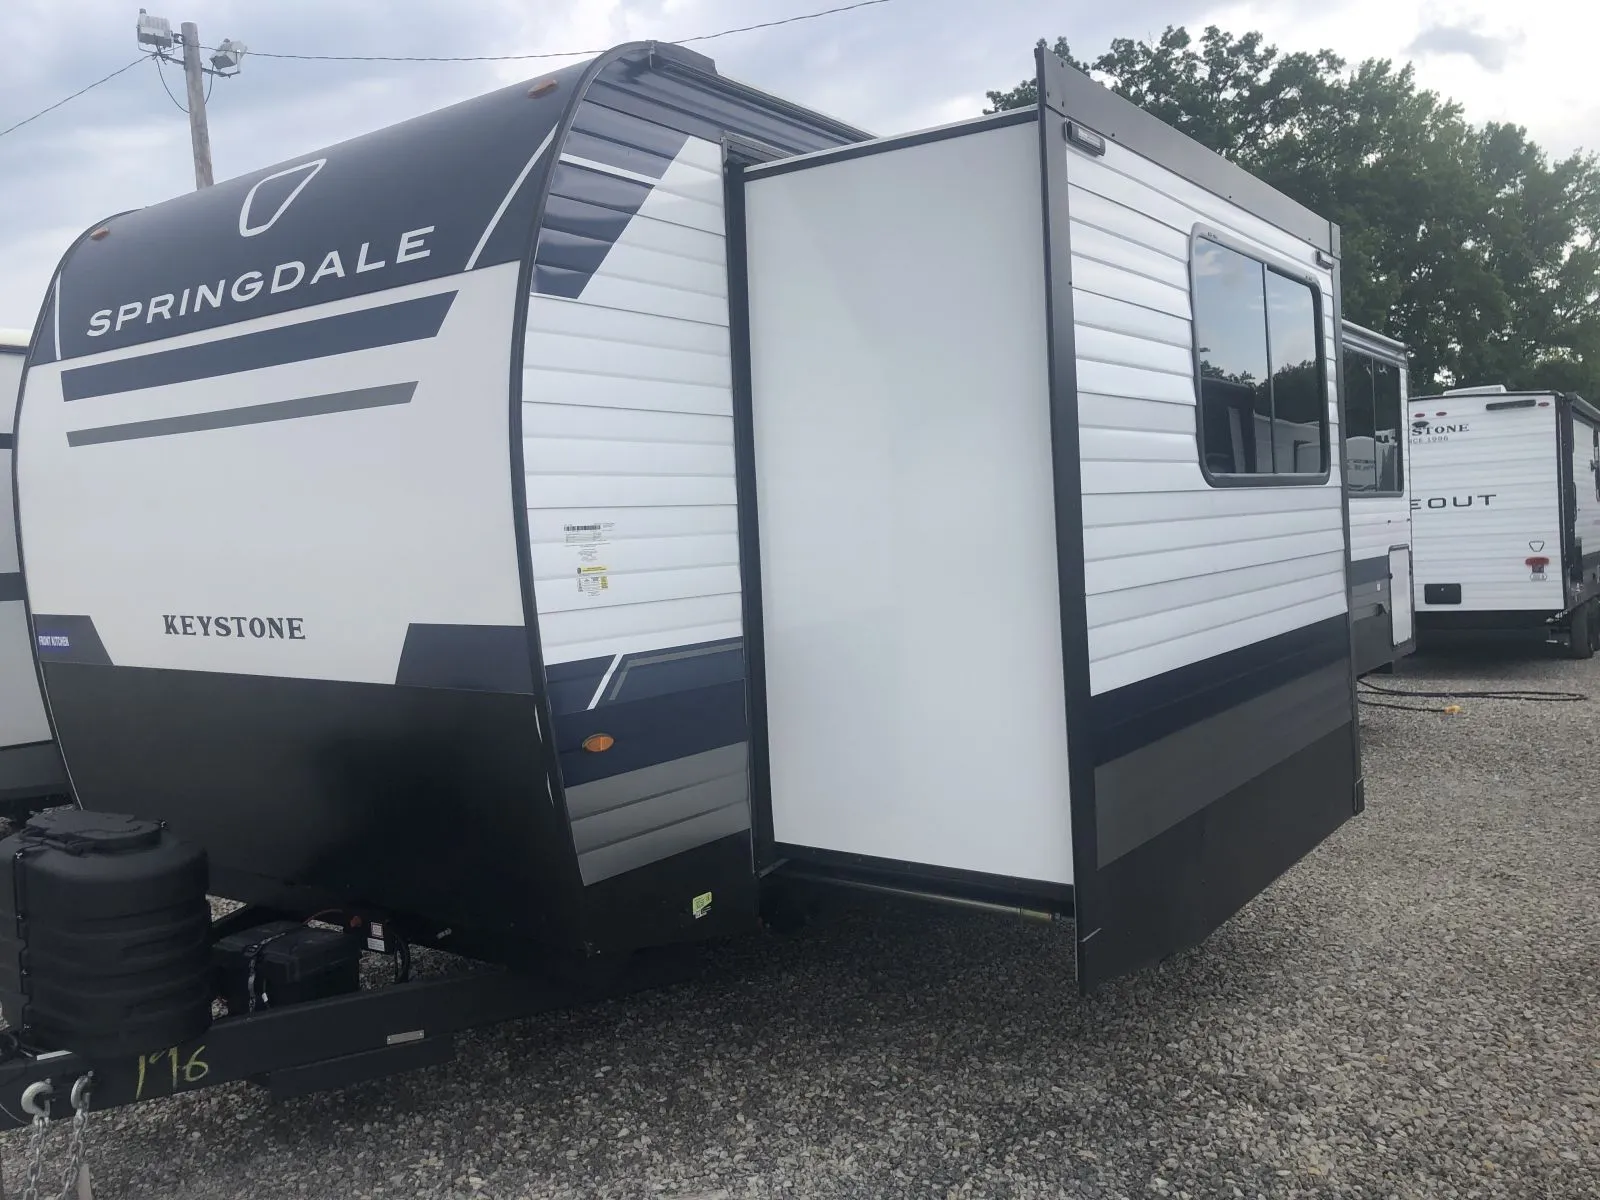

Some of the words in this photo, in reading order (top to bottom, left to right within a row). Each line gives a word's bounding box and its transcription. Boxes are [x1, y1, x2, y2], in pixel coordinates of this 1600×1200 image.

[87, 225, 435, 337] SPRINGDALE
[1411, 424, 1470, 436] STONE
[1410, 494, 1497, 510] EOUT
[162, 614, 306, 640] KEYSTONE
